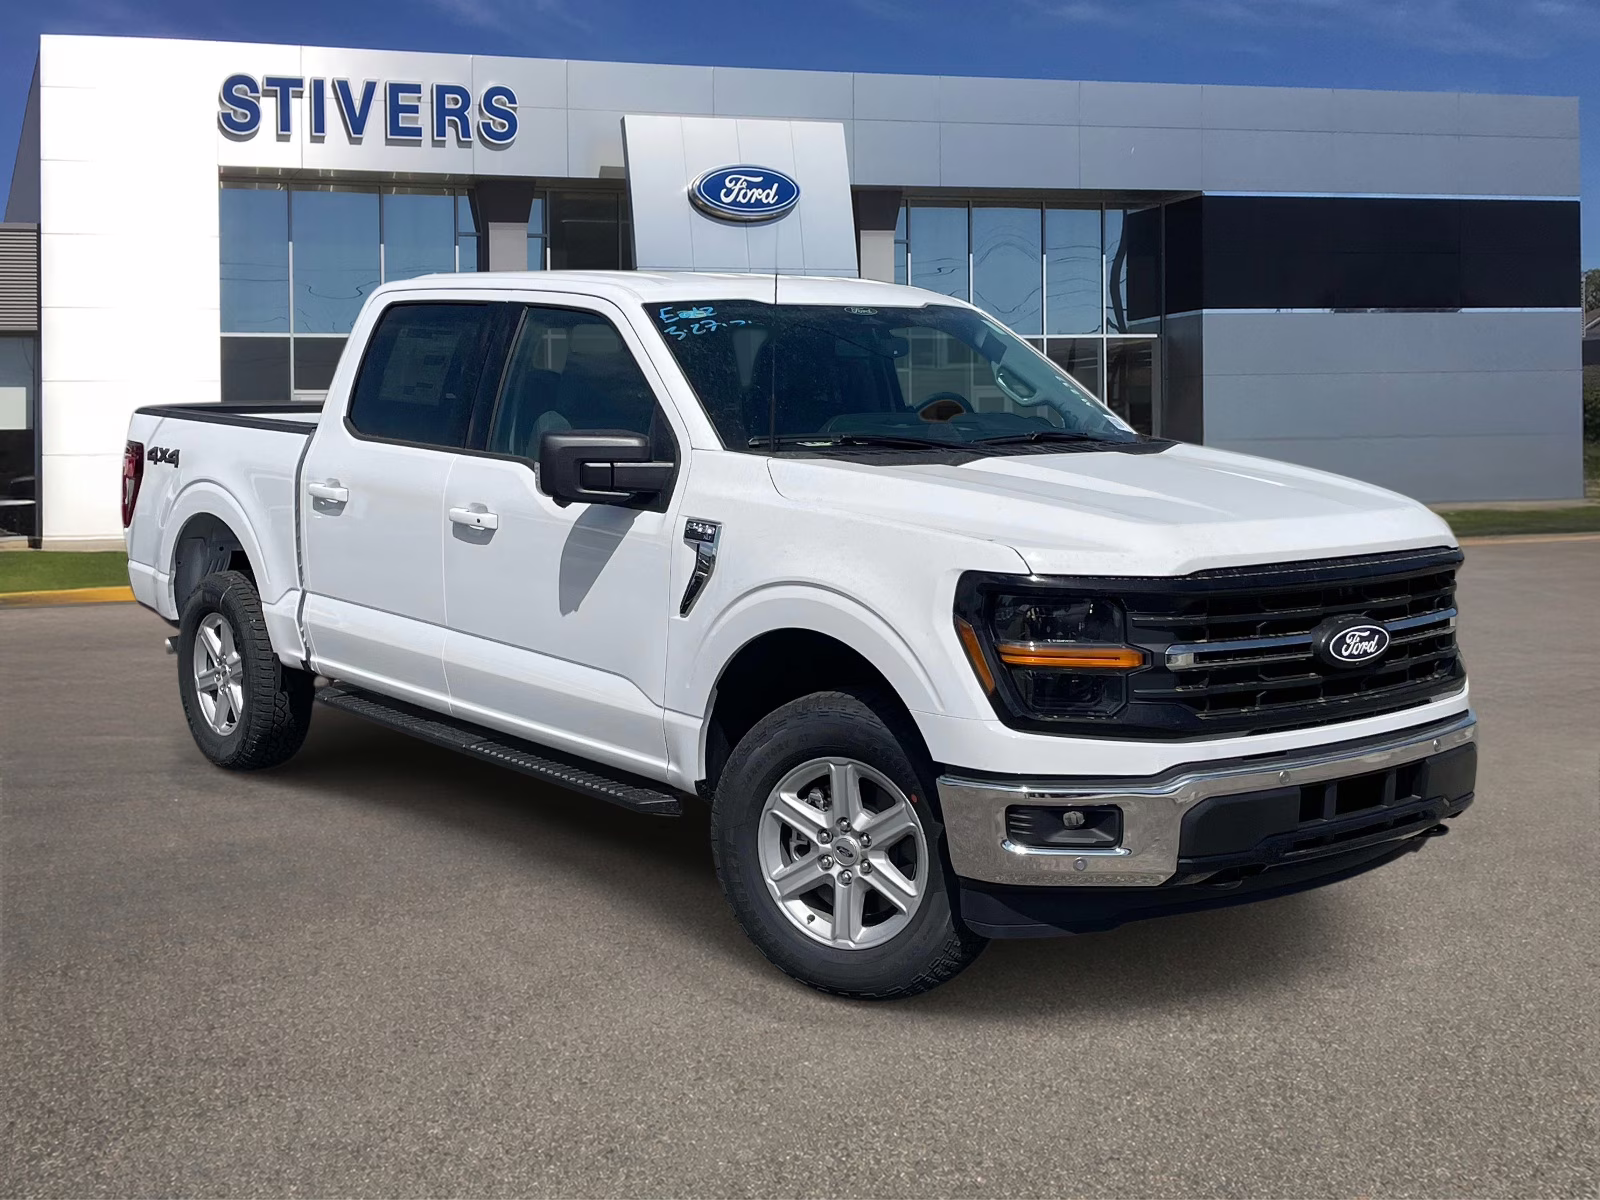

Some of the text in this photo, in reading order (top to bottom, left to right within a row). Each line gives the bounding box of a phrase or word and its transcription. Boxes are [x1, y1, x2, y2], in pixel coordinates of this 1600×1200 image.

[218, 73, 519, 147] STIVERS
[720, 174, 779, 204] Ford
[1341, 630, 1379, 657] Ford
